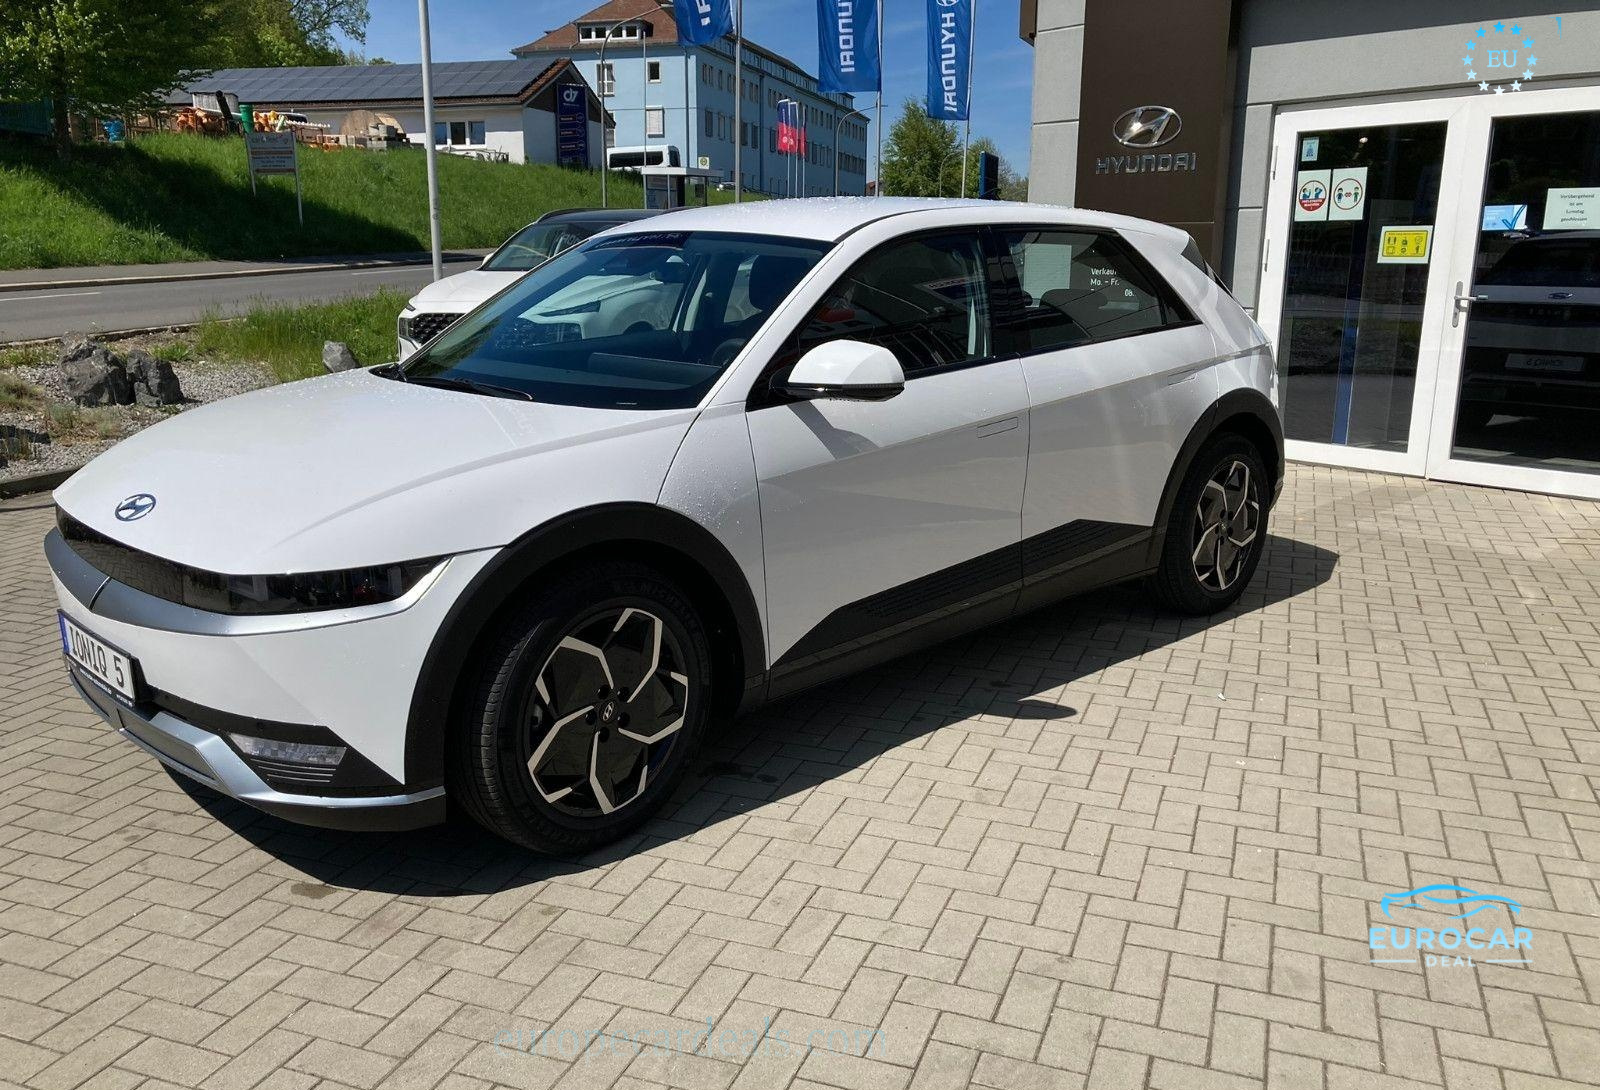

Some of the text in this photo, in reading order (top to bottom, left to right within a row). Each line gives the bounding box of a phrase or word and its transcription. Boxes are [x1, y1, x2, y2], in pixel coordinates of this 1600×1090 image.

[1095, 152, 1197, 175] HYUNDAI
[1090, 278, 1102, 286] Mo.
[1110, 278, 1120, 286] Fr.
[69, 625, 108, 679] IONIQ
[113, 654, 125, 688] 5
